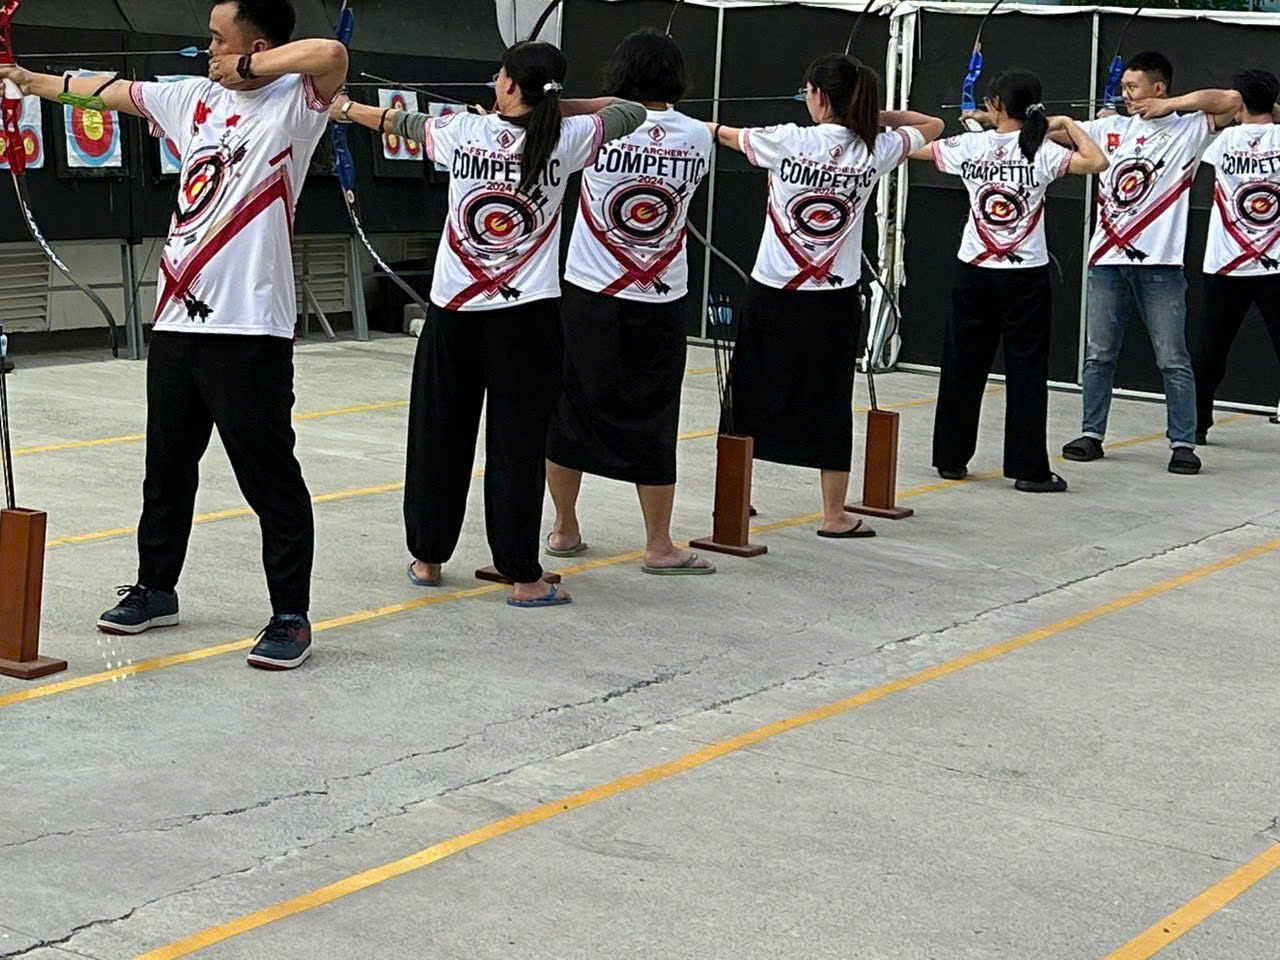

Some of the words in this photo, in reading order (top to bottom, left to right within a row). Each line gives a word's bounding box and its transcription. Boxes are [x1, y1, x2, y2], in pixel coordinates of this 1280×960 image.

[642, 146, 689, 158] ARCHERY
[452, 148, 561, 187] COMPEIC
[594, 145, 705, 185] COMPETTIC
[486, 181, 513, 192] 2024
[637, 175, 664, 186] 2024
